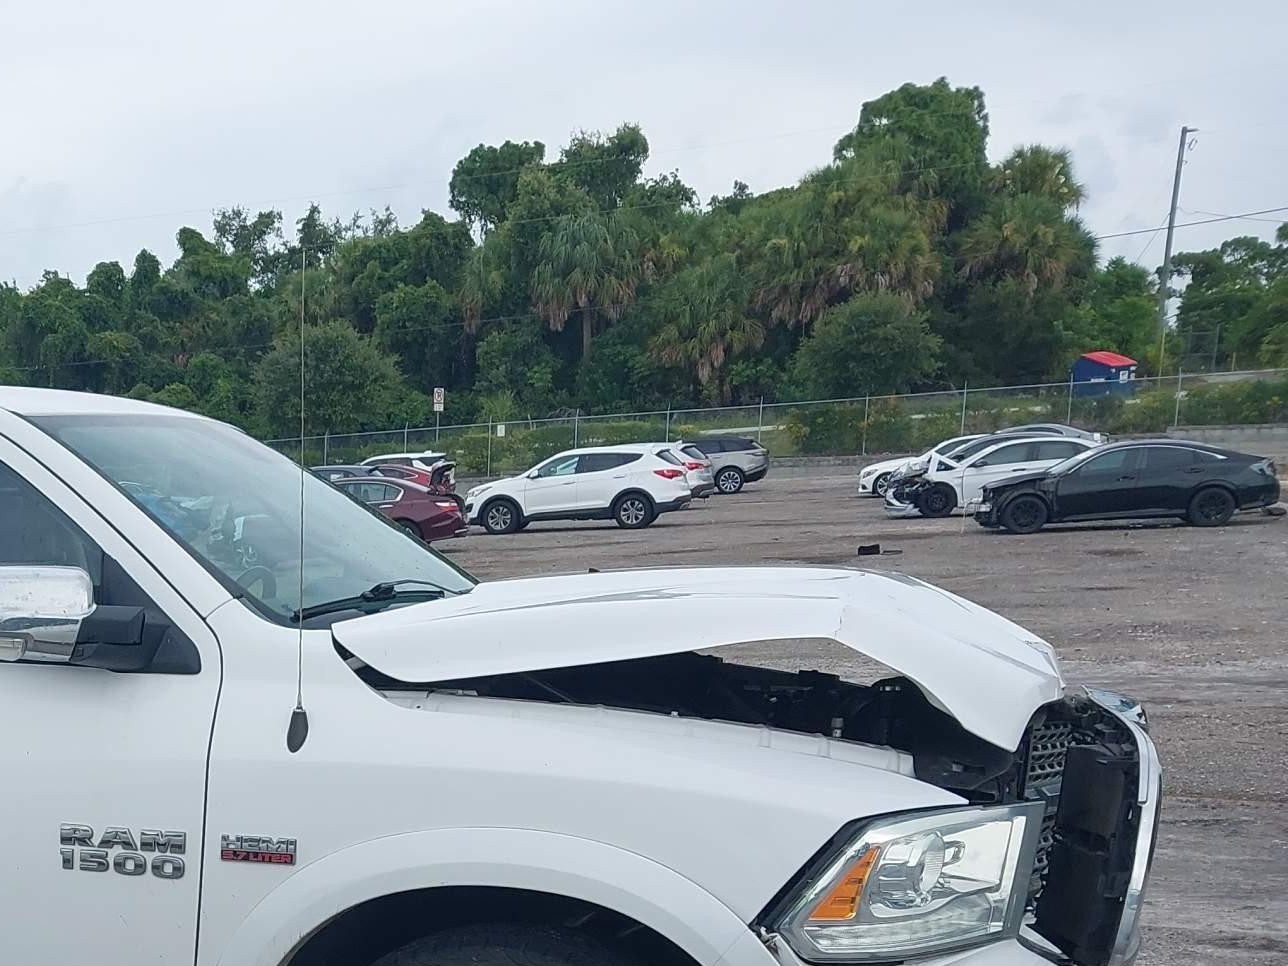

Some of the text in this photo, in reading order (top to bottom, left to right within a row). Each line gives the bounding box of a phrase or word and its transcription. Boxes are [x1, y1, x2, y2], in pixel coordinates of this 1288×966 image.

[60, 823, 187, 854] RAM
[221, 834, 297, 853] HEMI
[60, 847, 185, 880] 1500
[222, 850, 292, 864] 5.7 LITER
